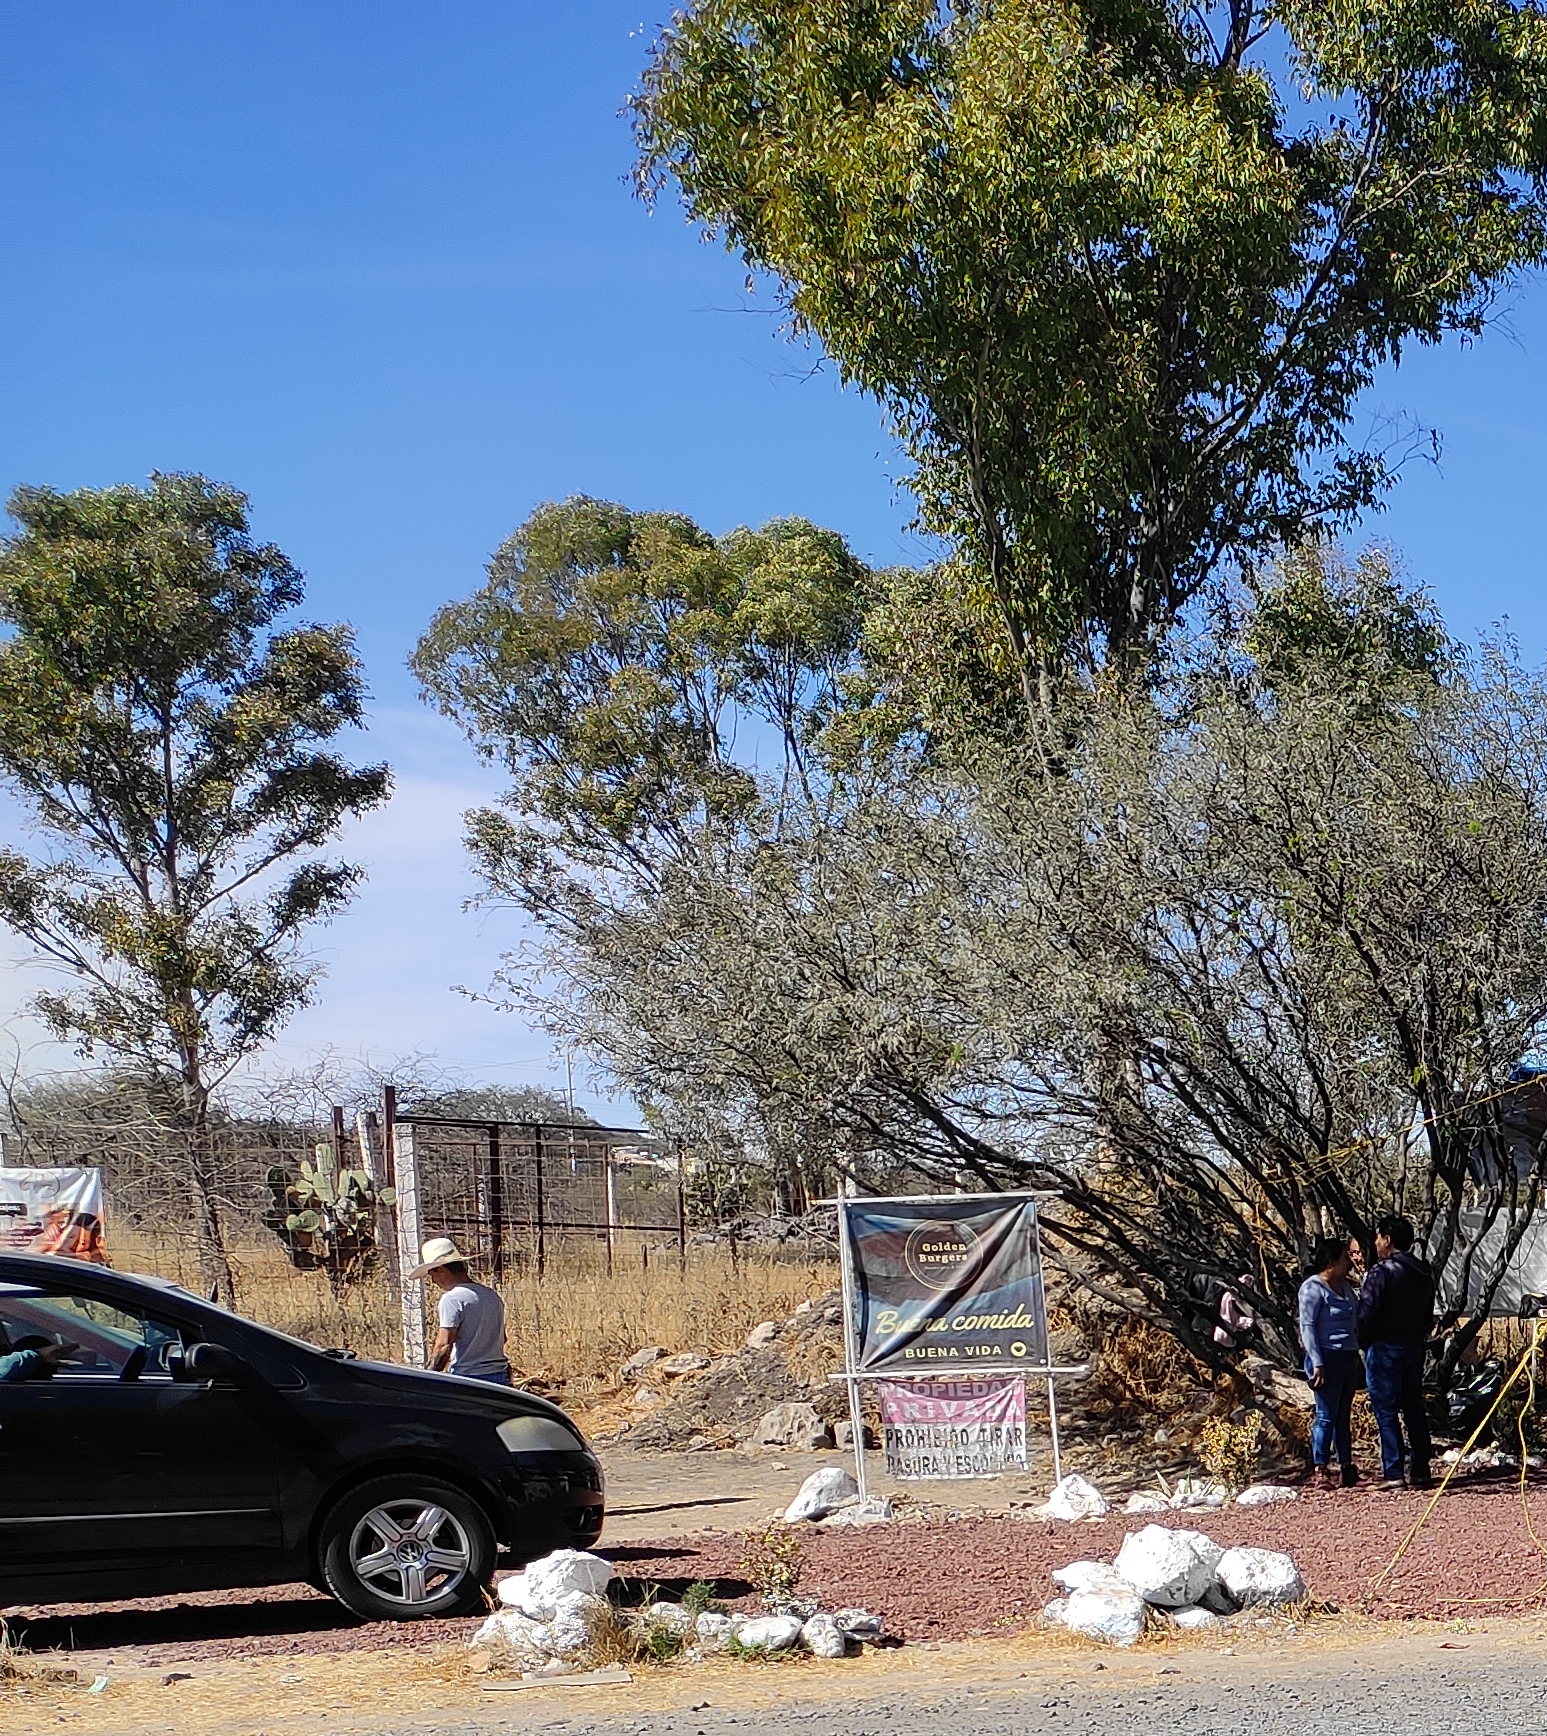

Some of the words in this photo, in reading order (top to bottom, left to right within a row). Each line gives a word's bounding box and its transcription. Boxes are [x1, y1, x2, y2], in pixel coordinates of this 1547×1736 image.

[922, 1241, 967, 1252] Golden
[918, 1253, 968, 1264] Burgers
[875, 1310, 949, 1335] Buena
[951, 1303, 1035, 1331] comida
[905, 1346, 959, 1359] BUENA
[964, 1345, 1002, 1357] VIDA
[979, 1427, 1023, 1448] TIRAR
